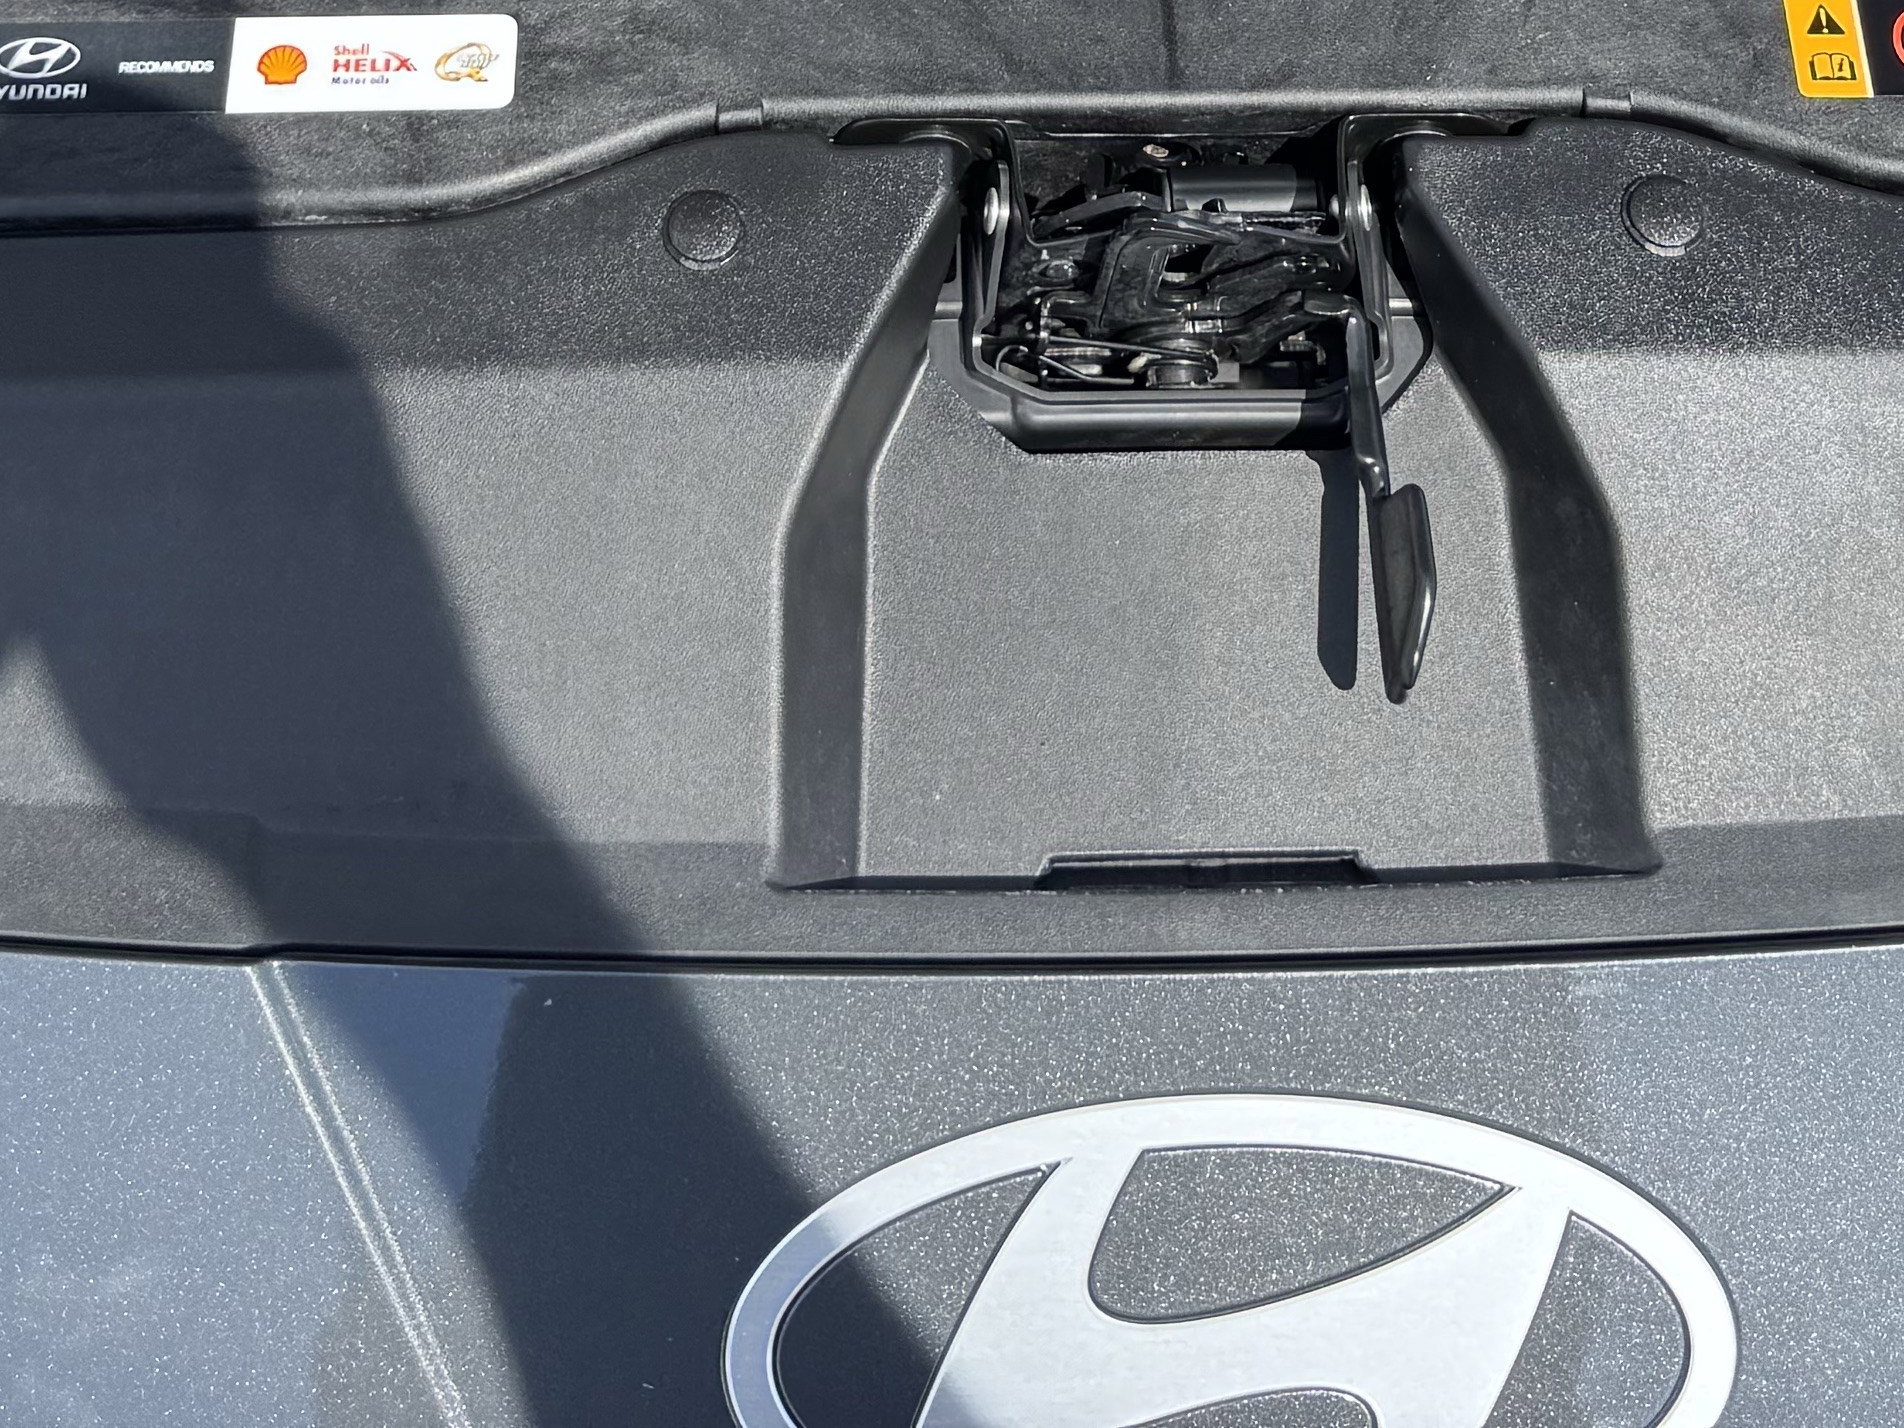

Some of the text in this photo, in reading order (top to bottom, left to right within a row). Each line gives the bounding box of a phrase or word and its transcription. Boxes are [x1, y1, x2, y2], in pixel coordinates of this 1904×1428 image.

[334, 43, 370, 56] Shell
[118, 60, 215, 74] RECOMMENDS
[332, 50, 418, 72] HELIX
[331, 75, 390, 85] Motor oils
